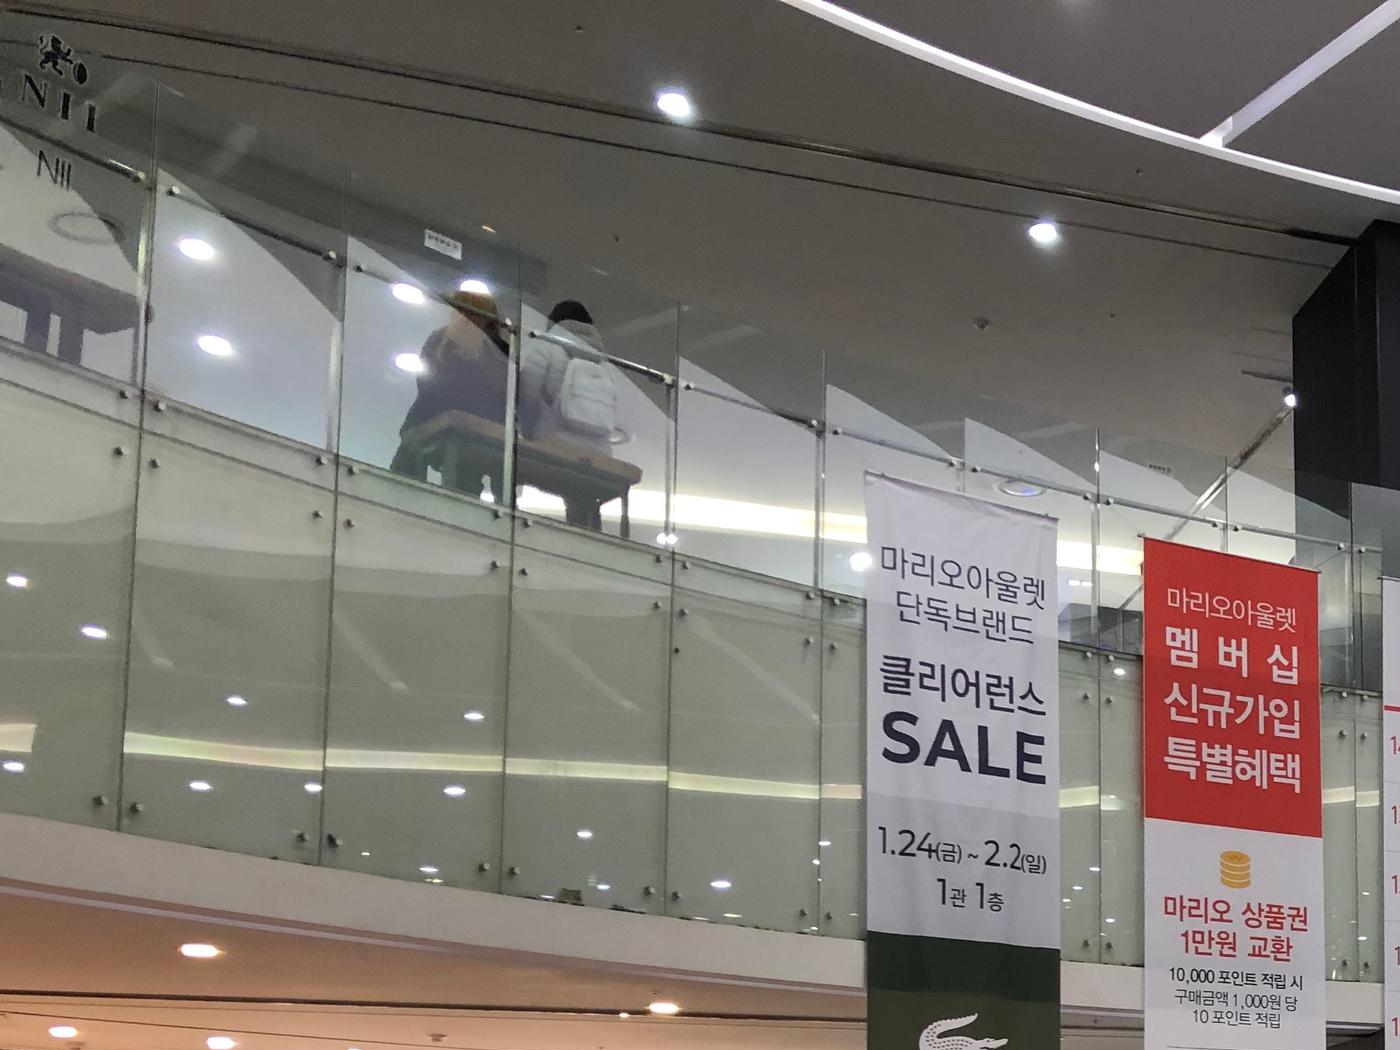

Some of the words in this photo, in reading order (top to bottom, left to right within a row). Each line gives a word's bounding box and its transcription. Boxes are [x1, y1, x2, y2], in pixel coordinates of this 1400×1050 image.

[20, 73, 97, 133] NII
[37, 150, 72, 190] NII
[880, 546, 1046, 610] 마리오아울렛
[896, 590, 1034, 645] 단독브랜드
[1167, 587, 1296, 633] 마리오아울렛
[880, 654, 1046, 717] 클리어런스
[1164, 682, 1300, 739] 신규가입
[881, 711, 1046, 785] SALE
[1164, 737, 1301, 794] 특별혜택
[878, 826, 962, 865] 1.24(금)
[937, 878, 967, 908] 1관
[975, 882, 1005, 912] 1층
[1164, 895, 1233, 924] 마리오
[1241, 902, 1308, 932] 상품권
[1181, 930, 1237, 958] 1만원
[1248, 935, 1293, 962] 교환
[1169, 967, 1215, 985] 10,000
[1218, 970, 1257, 987] 포인트
[1261, 973, 1287, 990] 적립
[1290, 976, 1303, 991] 시
[1174, 989, 1229, 1008] 구매금액
[1232, 993, 1281, 1011] 1,000원
[1285, 995, 1298, 1012] 당
[1192, 1009, 1209, 1024] 10
[1212, 1010, 1251, 1027] 포인트
[1255, 1012, 1281, 1029] 적립
